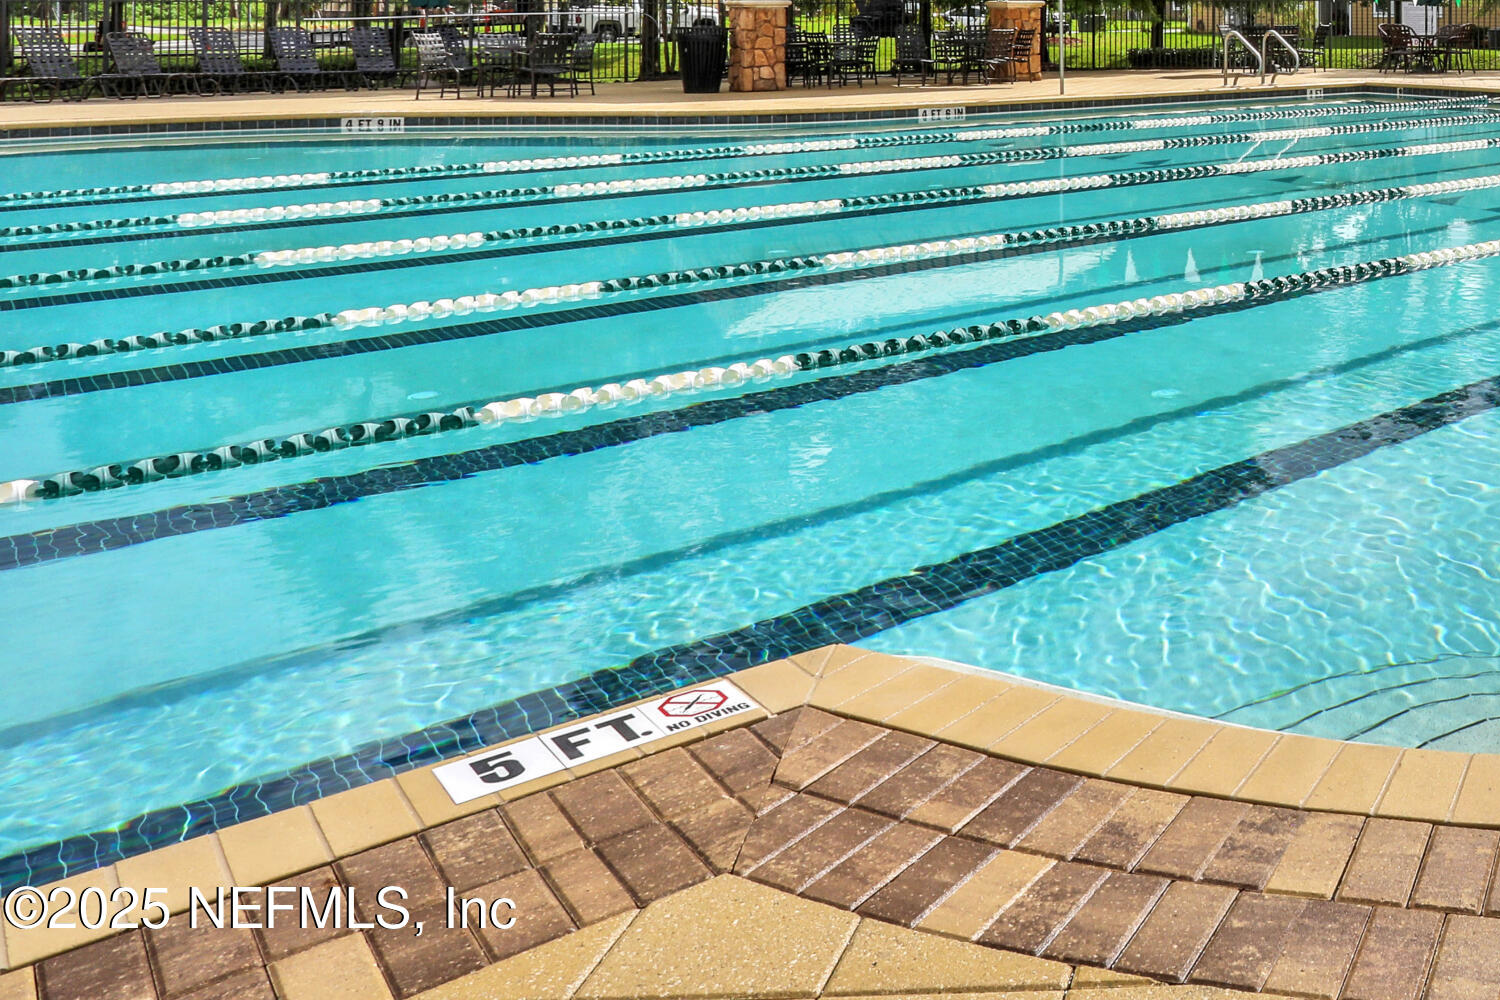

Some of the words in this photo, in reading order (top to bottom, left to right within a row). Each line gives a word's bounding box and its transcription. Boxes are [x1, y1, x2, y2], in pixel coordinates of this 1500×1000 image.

[666, 720, 692, 732] NO
[693, 701, 750, 723] DIVING
[469, 751, 526, 784] 5
[550, 713, 654, 761] FT.
